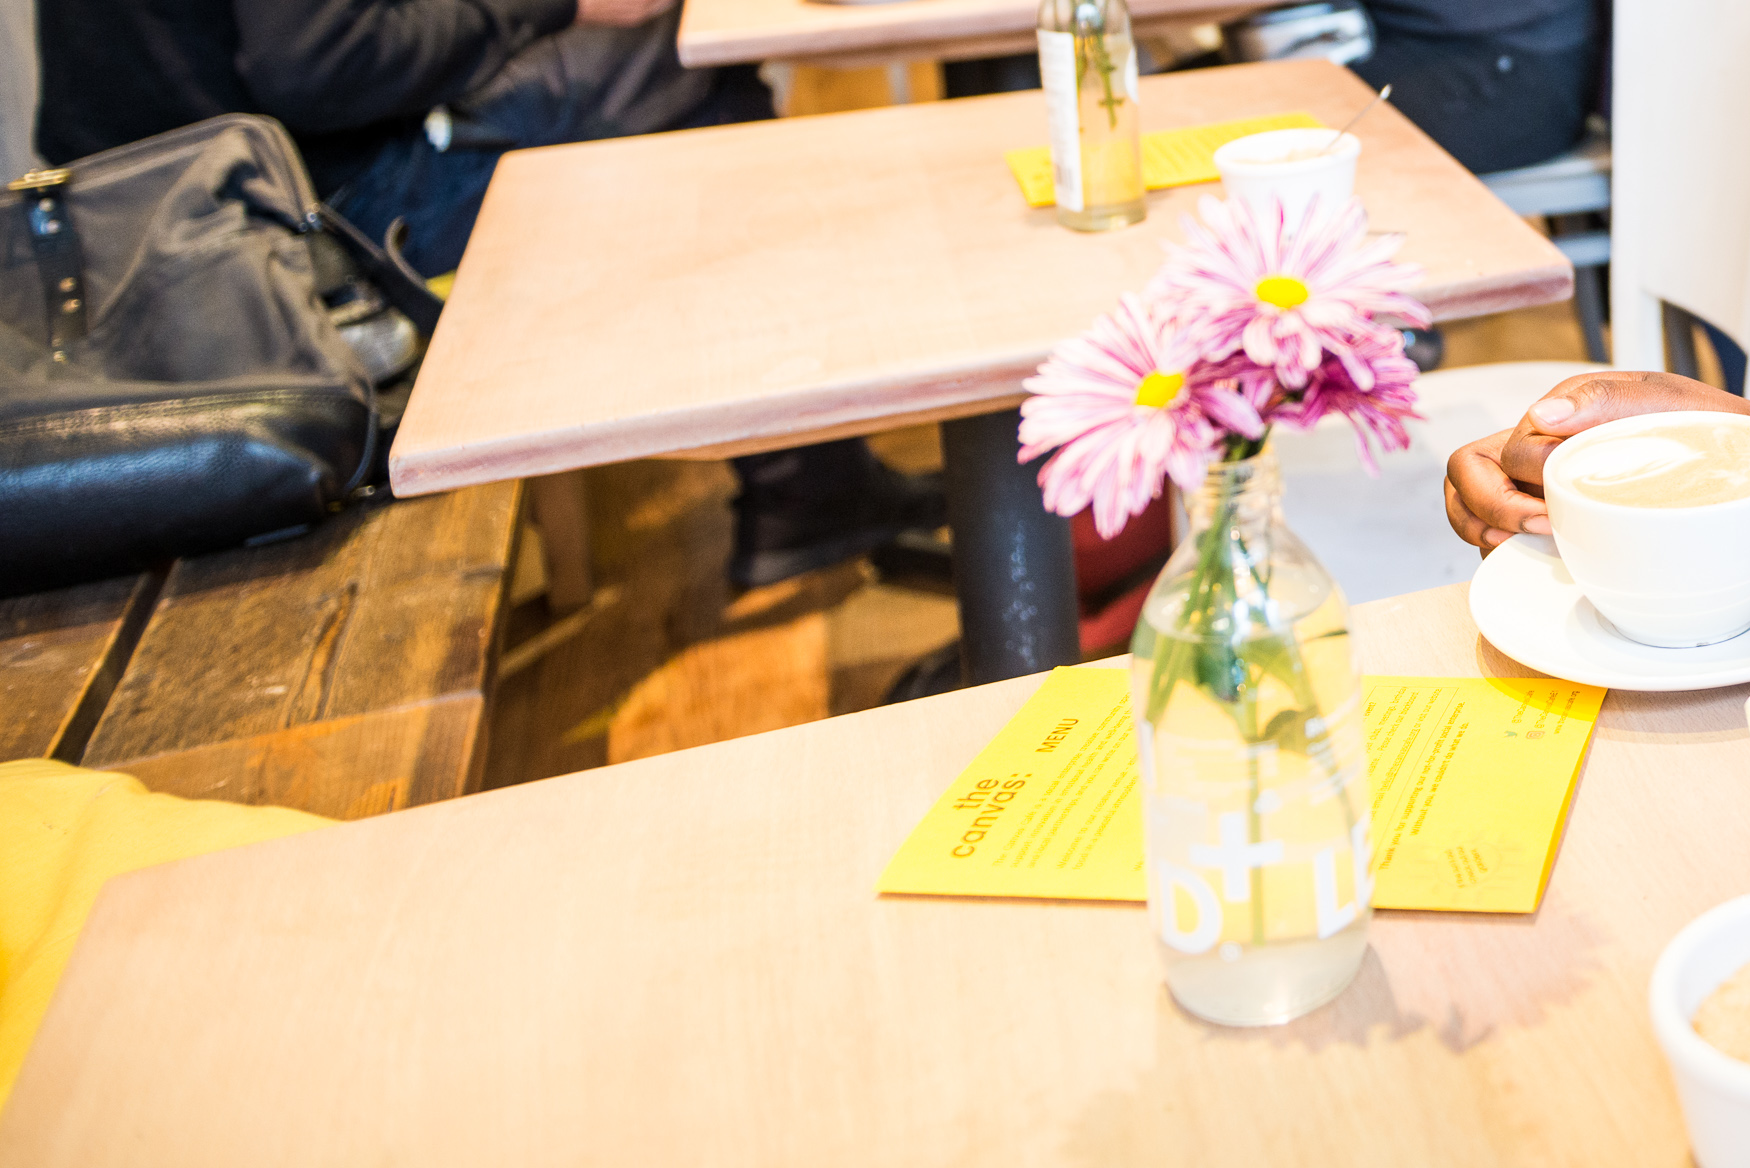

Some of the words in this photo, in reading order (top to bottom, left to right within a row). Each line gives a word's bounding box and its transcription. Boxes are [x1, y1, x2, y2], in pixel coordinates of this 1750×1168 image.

[1363, 701, 1377, 716] event?
[1377, 705, 1396, 725] meetings,
[1389, 686, 1409, 703] birthday
[1035, 718, 1079, 752] MENU
[1386, 723, 1399, 736] check
[1439, 725, 1451, 738] social
[1448, 738, 1461, 750] what
[1371, 792, 1385, 808] email
[1422, 704, 1432, 712] our
[1421, 739, 1444, 773] not-for-profit
[1003, 827, 1025, 850] Canvas
[1043, 780, 1060, 795] social
[1079, 732, 1099, 751] creative
[1096, 705, 1123, 730] community
[1416, 775, 1426, 785] our
[1429, 783, 1439, 792] we
[952, 778, 999, 809] the
[1036, 837, 1051, 853] local
[1074, 785, 1088, 795] and
[1085, 774, 1097, 783] you
[1092, 763, 1105, 773] can
[1401, 787, 1423, 819] supporting
[1423, 793, 1436, 807] you,
[950, 772, 1031, 858] canvas:
[1011, 841, 1032, 867] support
[1030, 805, 1056, 837] innovation
[1059, 769, 1084, 795] emotional
[1056, 836, 1082, 868] Welcome
[1084, 814, 1097, 825] our
[1093, 789, 1114, 812] creative
[1111, 771, 1127, 787] venue
[1393, 821, 1406, 831] for
[1410, 808, 1428, 835] Without
[1071, 853, 1089, 869] food
[1094, 810, 1116, 836] peaceful
[1390, 833, 1402, 845] you
[1378, 847, 1396, 869] Thank
